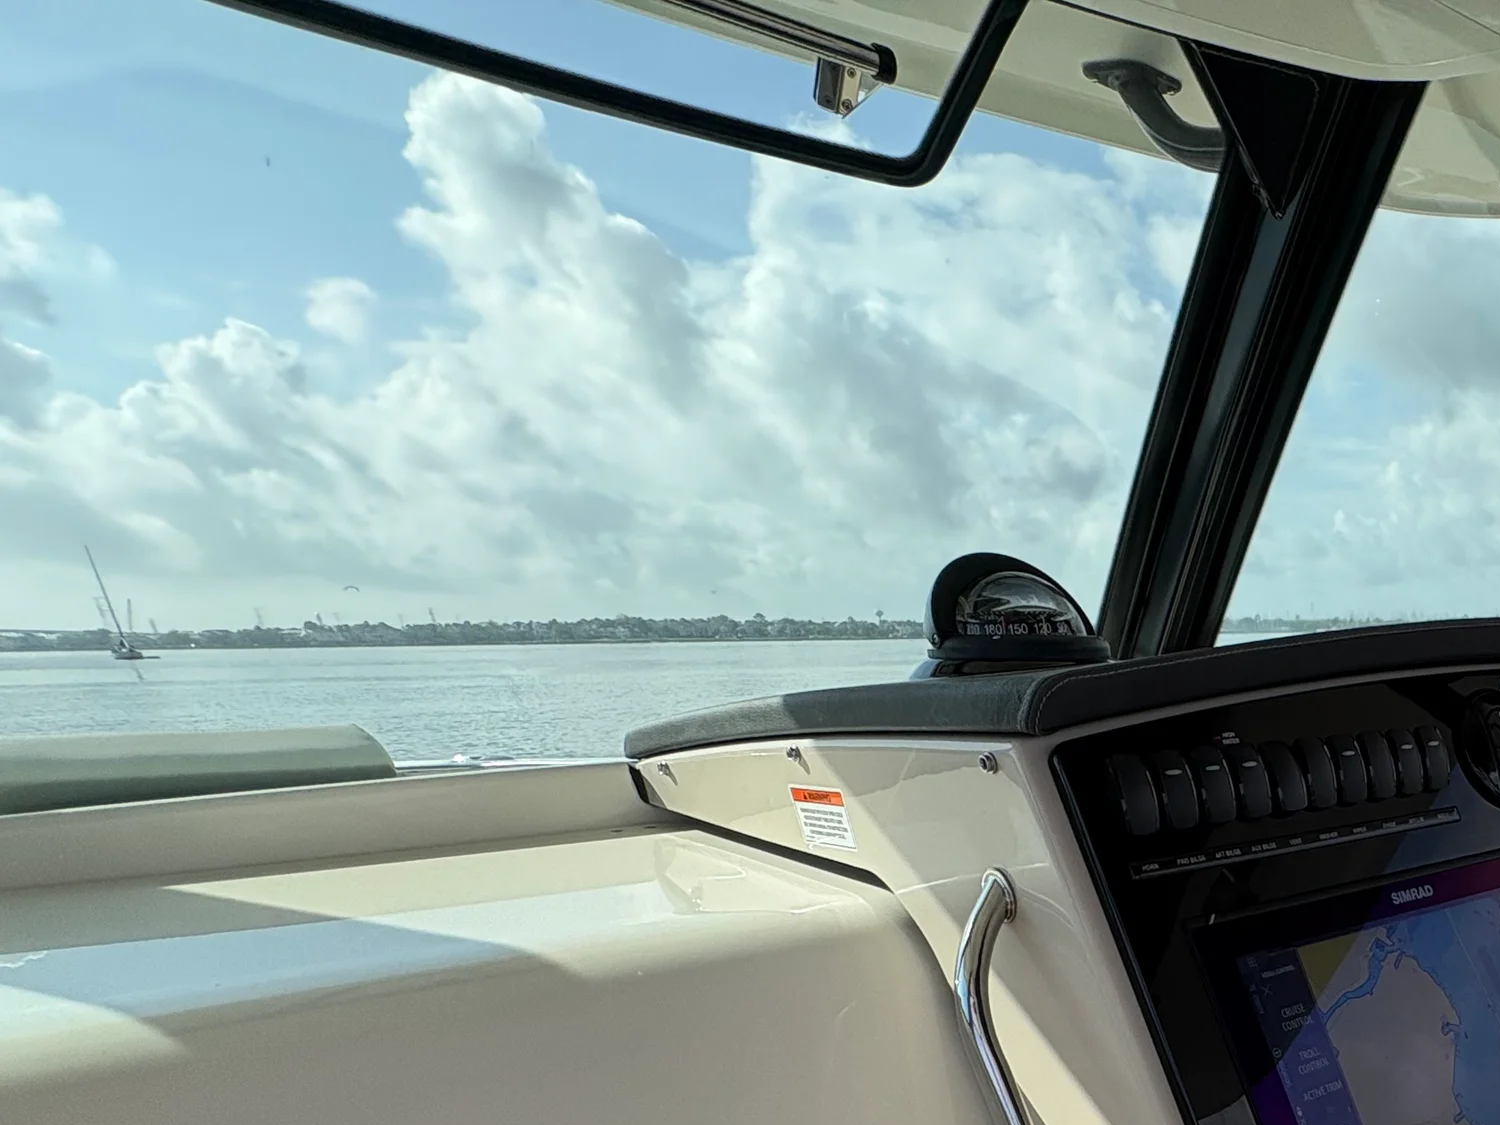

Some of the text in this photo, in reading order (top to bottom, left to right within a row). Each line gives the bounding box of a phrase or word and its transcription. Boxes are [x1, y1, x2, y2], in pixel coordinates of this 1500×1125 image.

[984, 623, 1003, 635] 180
[1008, 623, 1028, 635] 150
[1034, 622, 1052, 634] 120
[1391, 884, 1434, 905] SIMRAD
[1281, 1003, 1306, 1018] CRUISE
[1281, 1014, 1314, 1031] CONTROL
[1299, 1047, 1321, 1060] TROLL
[1298, 1057, 1329, 1075] CONTROL
[1303, 1079, 1343, 1102] ACTIVE TRIM
